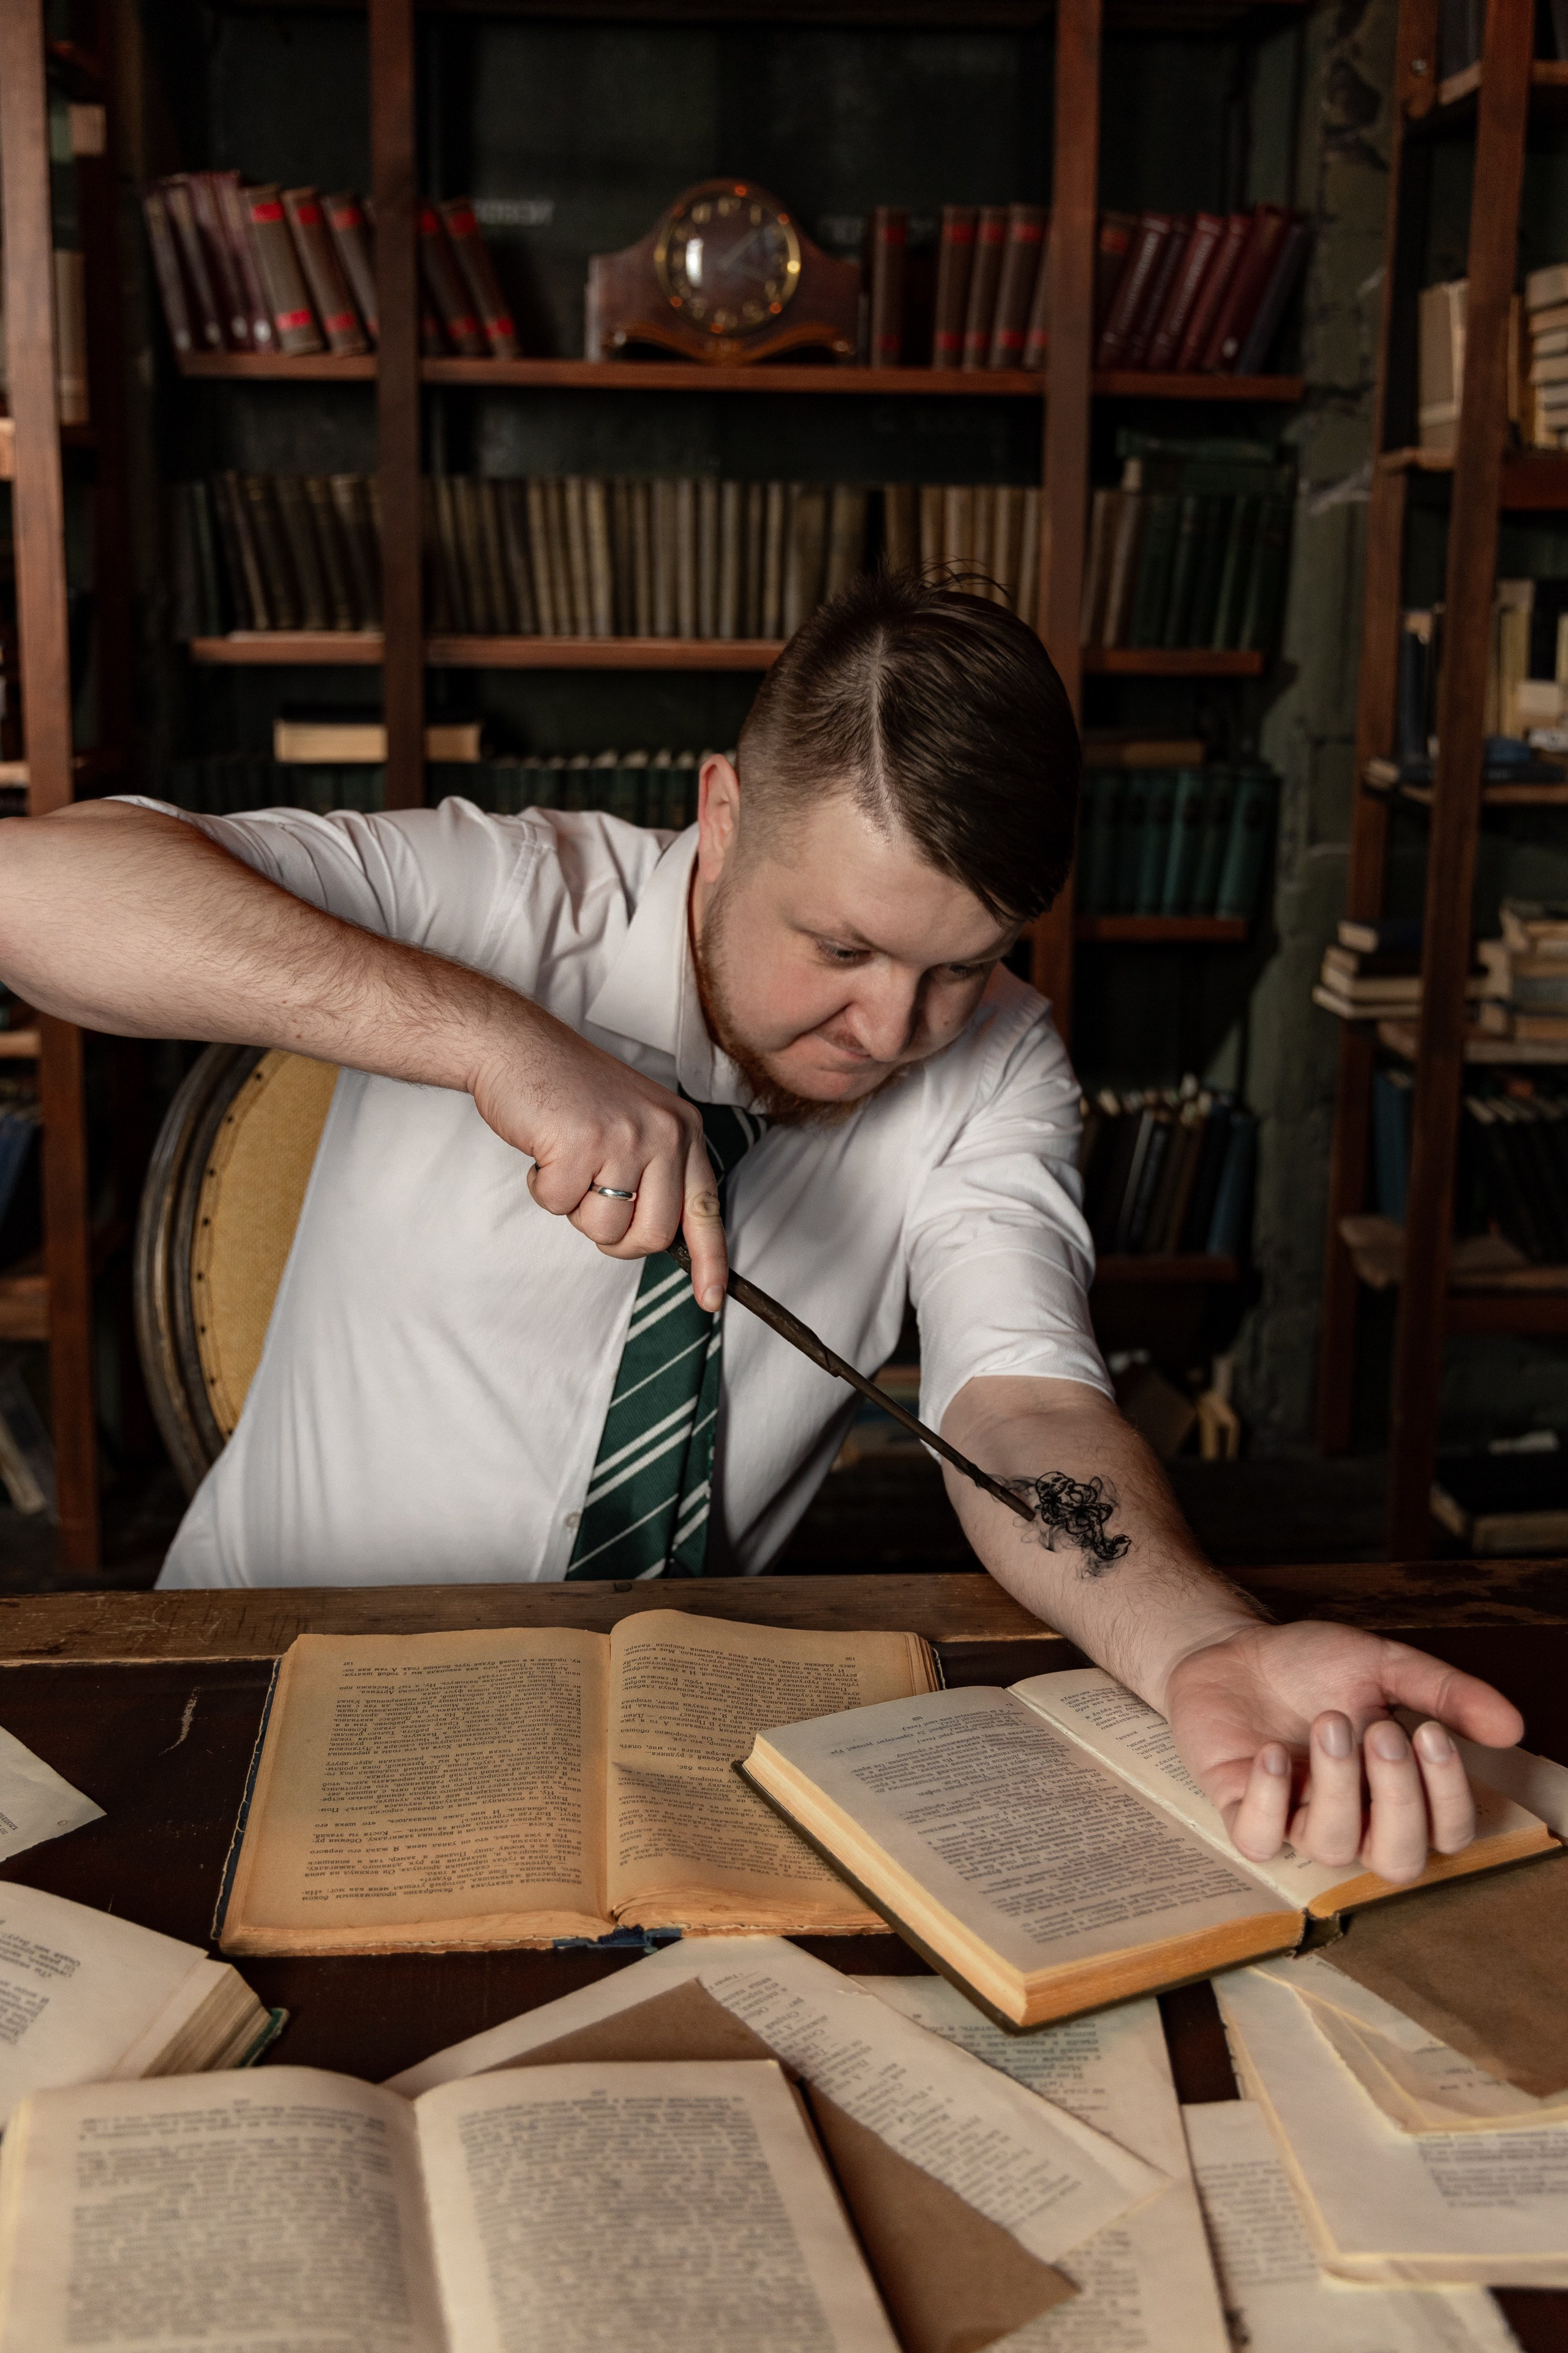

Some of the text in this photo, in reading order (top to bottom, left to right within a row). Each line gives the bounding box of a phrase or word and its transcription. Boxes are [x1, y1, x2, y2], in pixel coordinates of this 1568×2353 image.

[622, 1664, 649, 1673] добрые
[736, 1677, 779, 1686] наклонился
[674, 1722, 714, 1731] отозвался.
[429, 1797, 470, 1805] шкатулки
